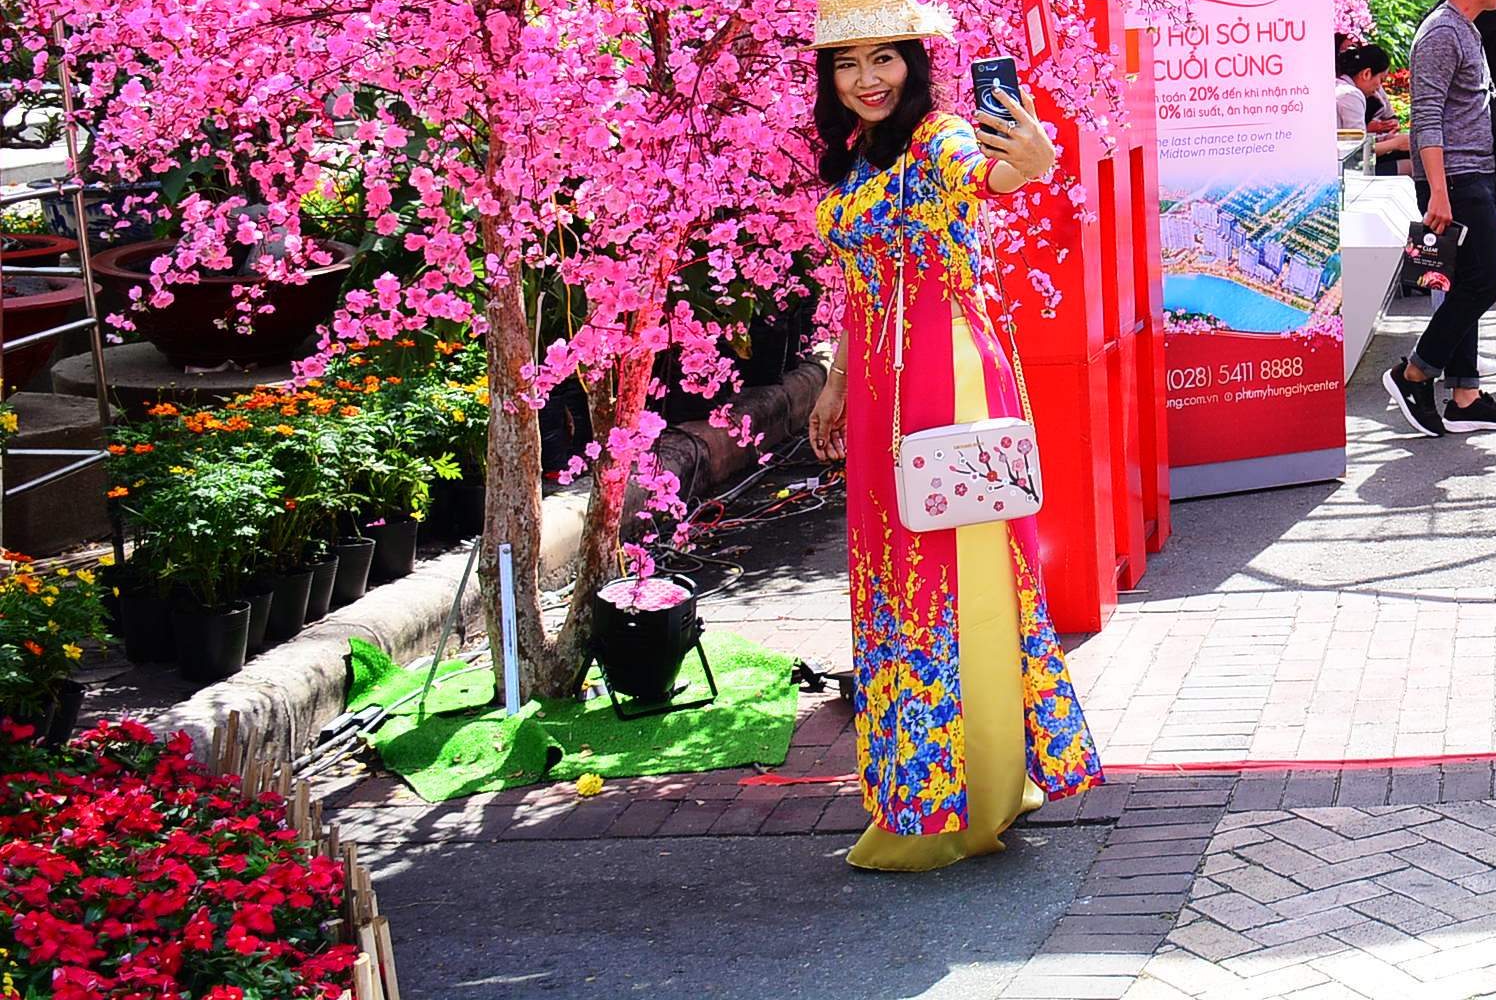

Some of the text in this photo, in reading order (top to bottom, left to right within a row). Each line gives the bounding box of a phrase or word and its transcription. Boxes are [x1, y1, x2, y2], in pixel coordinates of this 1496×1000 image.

[1217, 16, 1251, 45] SỞ
[1257, 18, 1306, 43] HỮU
[1153, 50, 1283, 82] CUỐI CÙNG
[1162, 92, 1187, 103] toán
[1189, 86, 1220, 102] 20%
[1222, 89, 1242, 100] đến
[1244, 87, 1260, 98] khi
[1262, 86, 1288, 99] nhận
[1290, 85, 1310, 96] nhà
[1158, 104, 1181, 120] 0%
[1171, 136, 1191, 147] last
[1194, 133, 1234, 145] chance
[1237, 132, 1248, 142] to
[1250, 131, 1272, 141] own
[1275, 130, 1293, 140] the
[1159, 142, 1275, 160] Midtown masterpiece
[1166, 356, 1304, 391] (028) 5411 8888
[1235, 380, 1340, 403] phumyhungcitycenter
